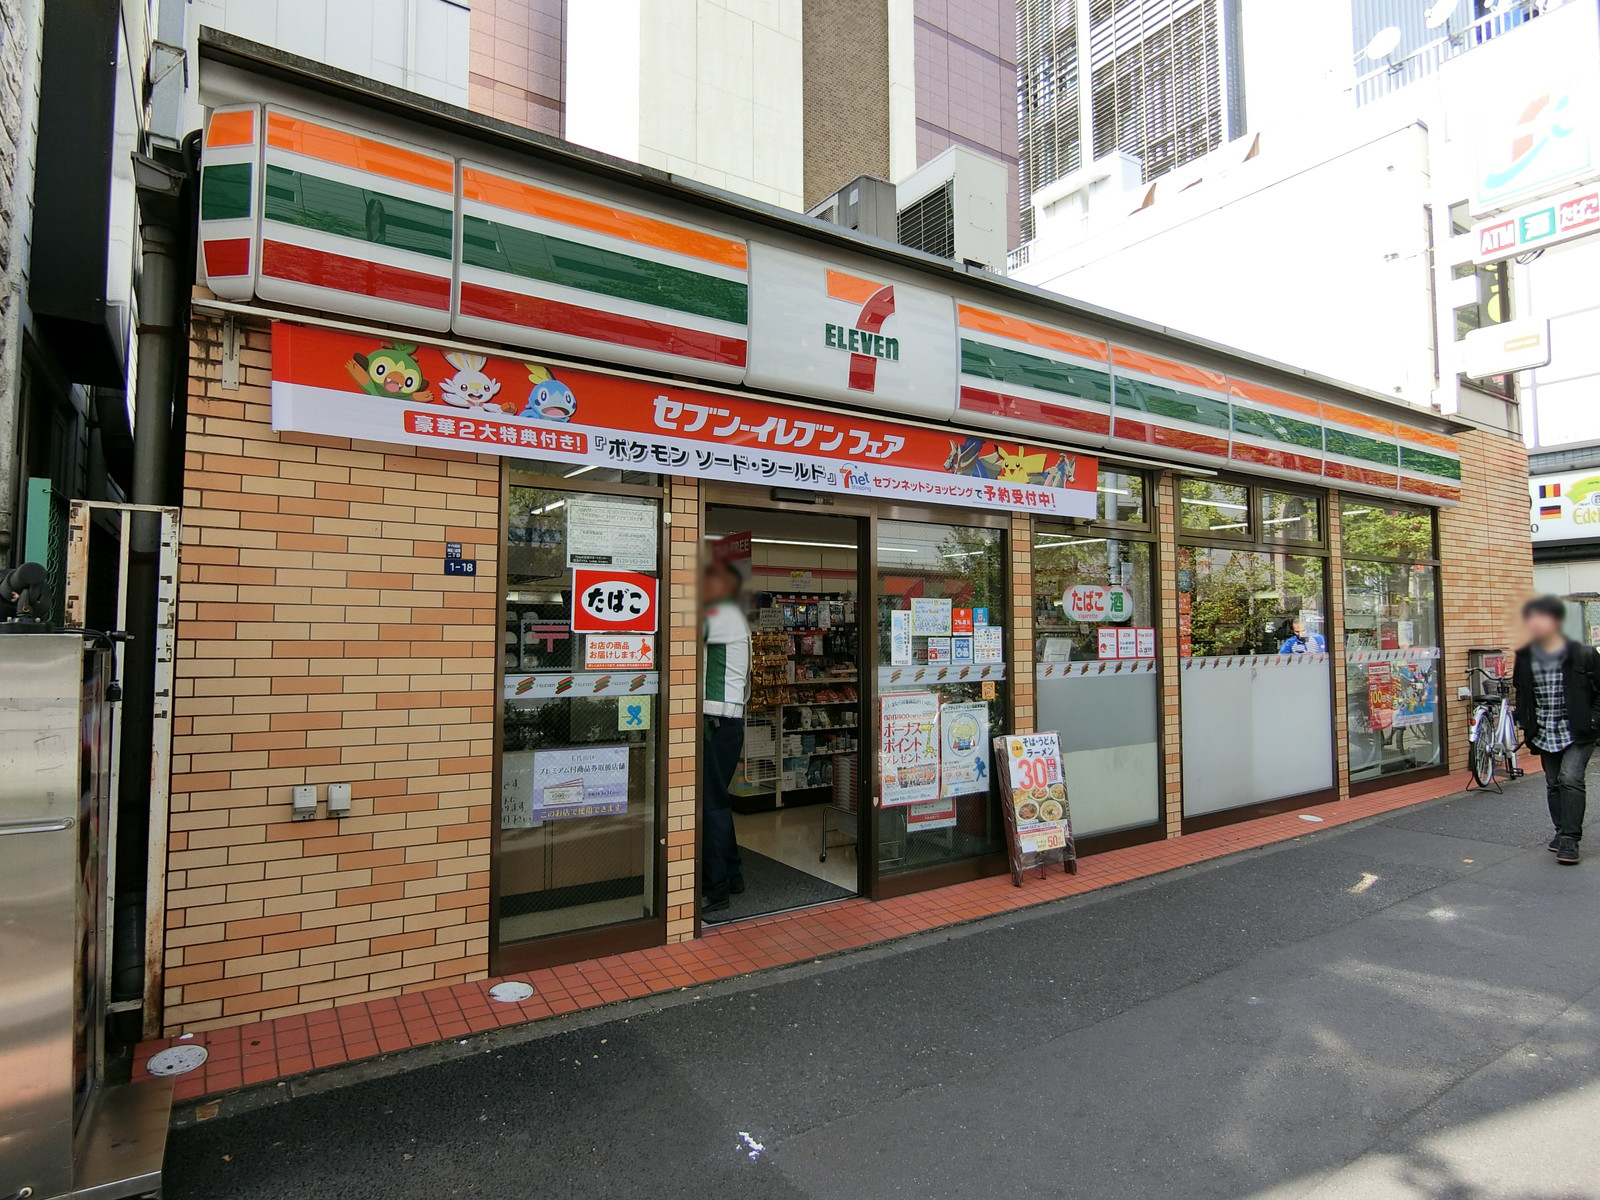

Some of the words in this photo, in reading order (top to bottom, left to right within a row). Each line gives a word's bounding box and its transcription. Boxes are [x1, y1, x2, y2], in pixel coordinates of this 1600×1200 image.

[1481, 222, 1515, 253] ATM
[825, 268, 895, 393] 7
[414, 414, 582, 452] 豪華2大特典付き!
[449, 562, 474, 572] 1-18
[587, 587, 642, 614] たばこ
[1071, 590, 1104, 612] たばこ
[1109, 591, 1124, 612] 酒
[589, 641, 630, 650] お店の商品
[883, 722, 923, 738] ボーナス
[883, 738, 922, 754] ポイント
[1026, 748, 1054, 758] ラーメン
[884, 754, 921, 765] プレゼント
[1017, 758, 1047, 790] 30
